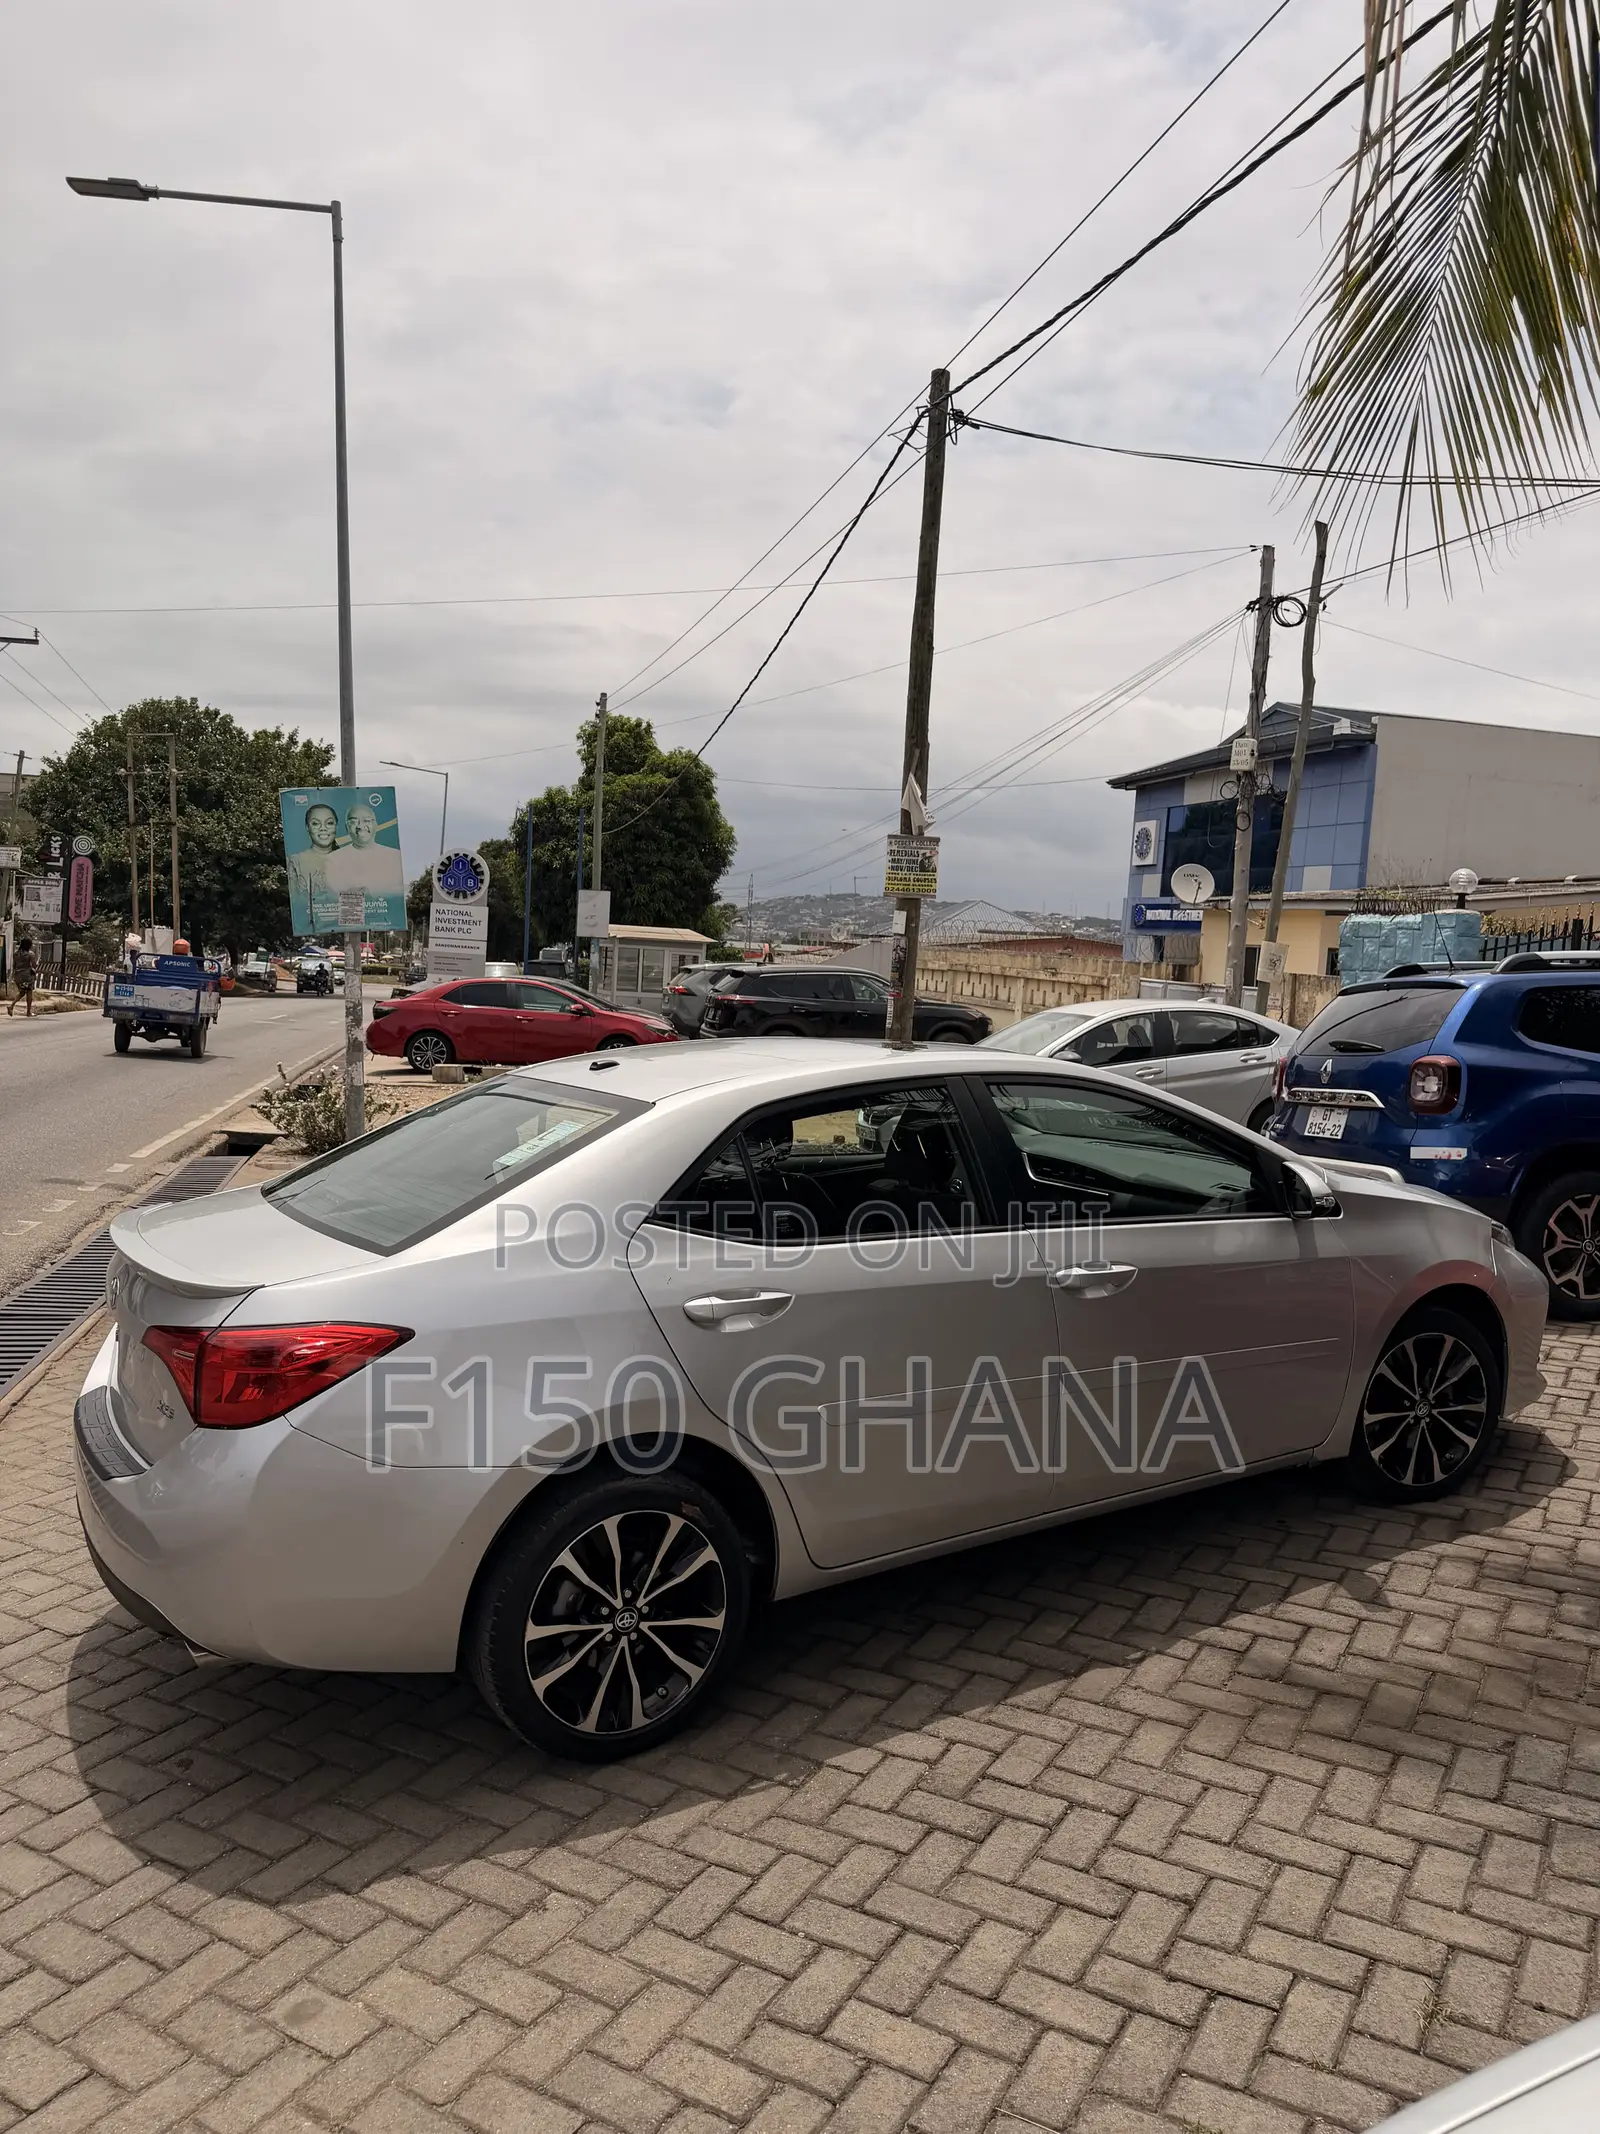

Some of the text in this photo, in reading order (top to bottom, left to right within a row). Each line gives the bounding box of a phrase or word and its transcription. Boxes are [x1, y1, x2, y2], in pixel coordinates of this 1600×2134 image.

[889, 849, 920, 857] REMEDIALS
[435, 908, 474, 918] NATIONAL
[435, 917, 482, 927] INVESTMENT
[434, 926, 472, 935] BANK PLC
[163, 960, 191, 968] APSONIC
[1322, 1108, 1335, 1121] GT
[1307, 1121, 1342, 1138] 8154-22
